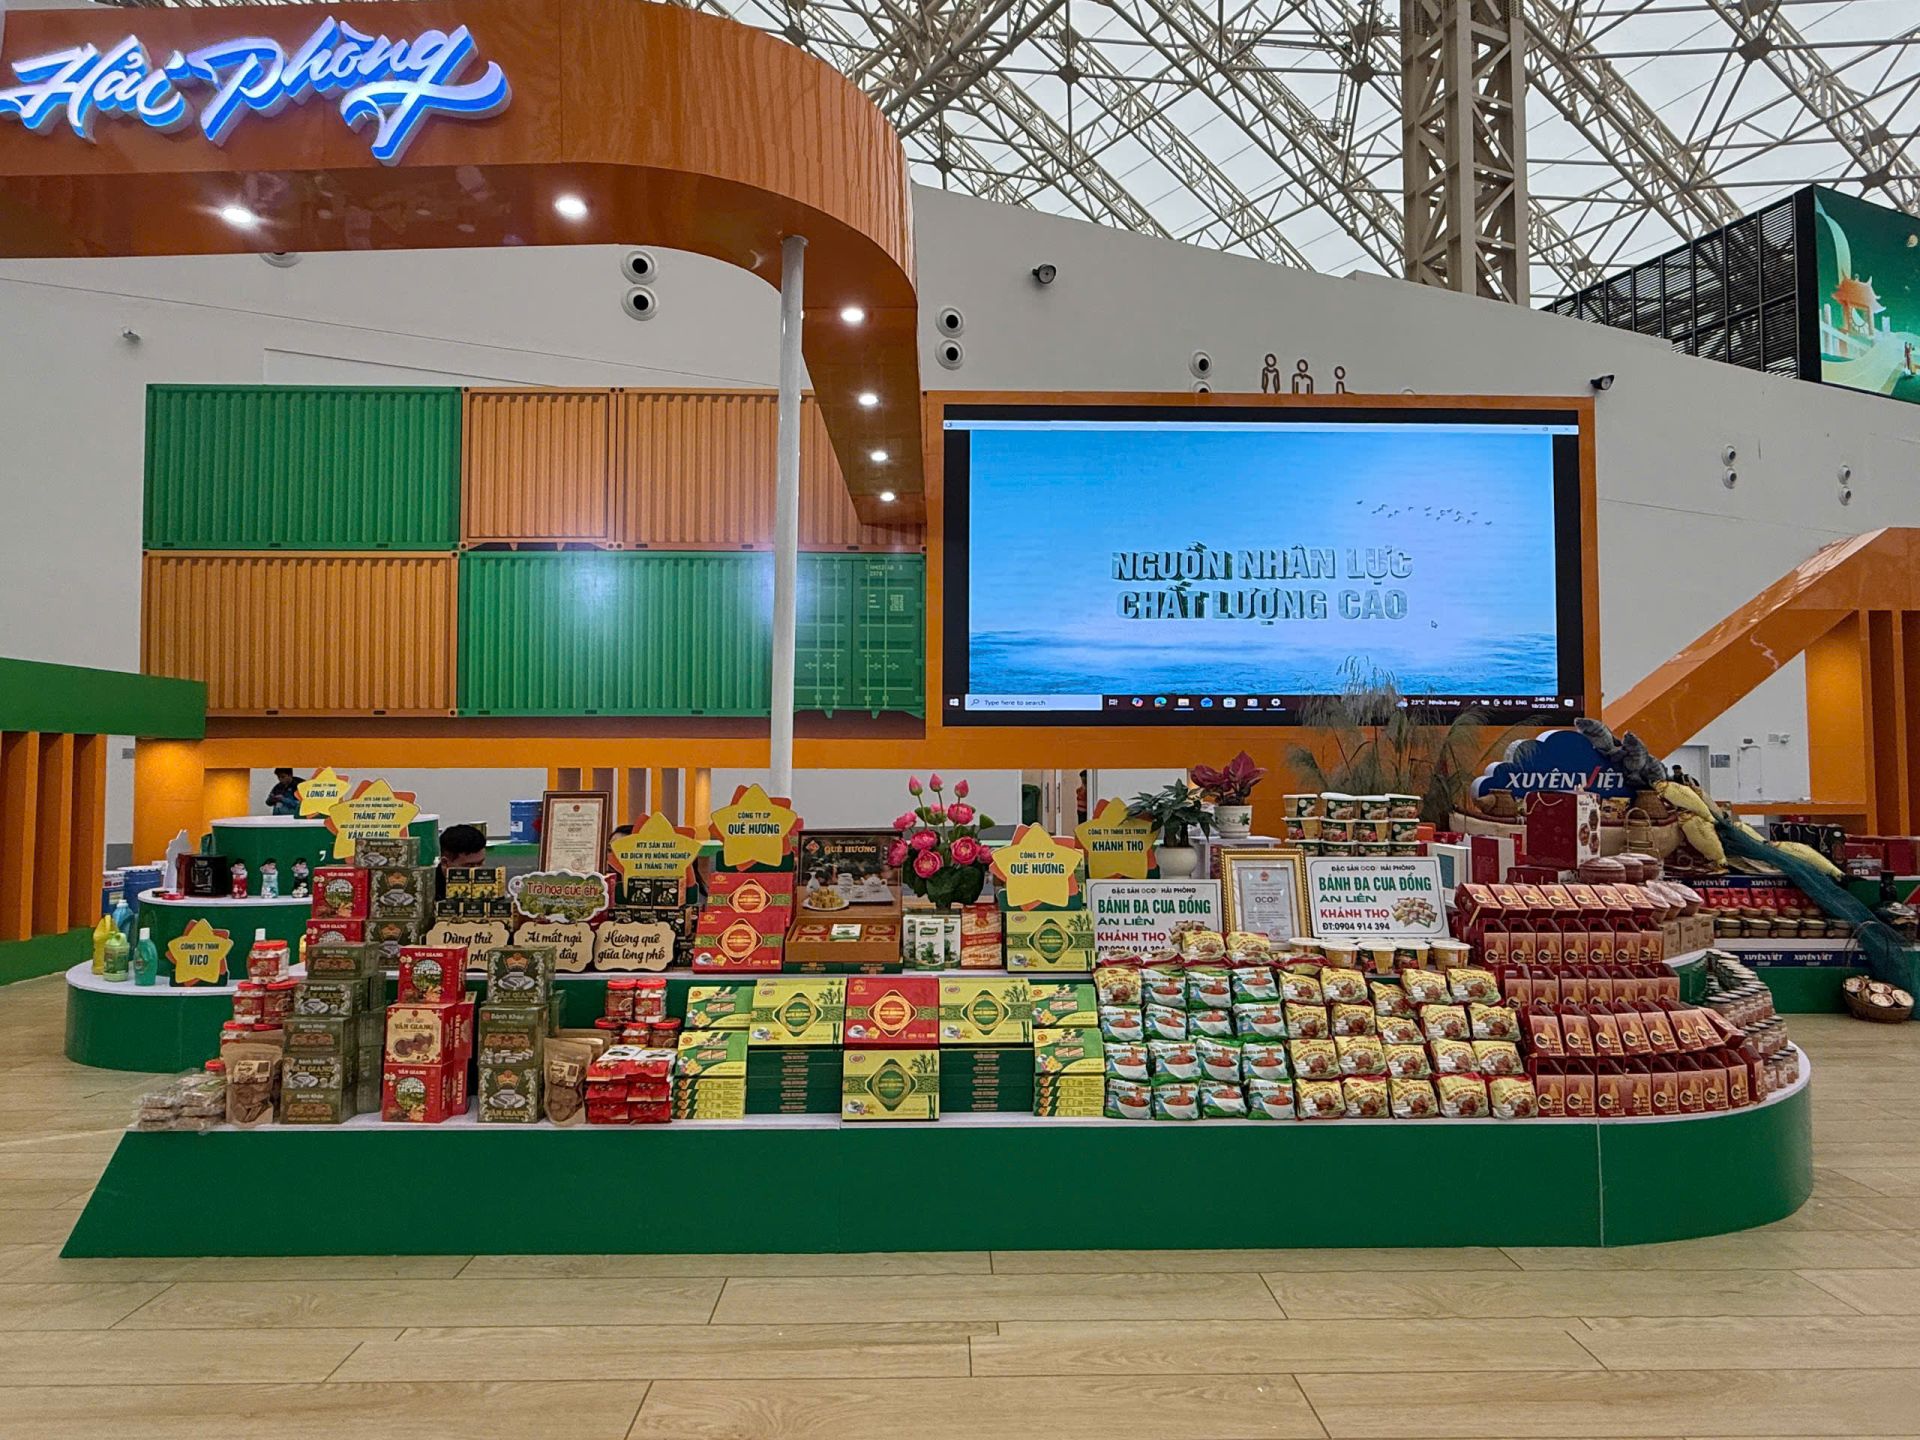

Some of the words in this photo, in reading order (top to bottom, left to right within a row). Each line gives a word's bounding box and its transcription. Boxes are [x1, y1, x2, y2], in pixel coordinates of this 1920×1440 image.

[190, 15, 511, 166] Phòng
[1111, 541, 1233, 580] NGUỒN
[1237, 543, 1336, 580] NHÂN
[1346, 545, 1414, 585] LỰC
[1116, 581, 1209, 620] CHẤT
[1212, 587, 1328, 626] LƯỢNG
[1338, 588, 1410, 620] CAO
[306, 790, 325, 798] LONG
[738, 811, 753, 819] CÔNG
[728, 822, 745, 836] QUÊ
[748, 823, 780, 835] HƯƠNG
[1092, 839, 1124, 852] KHÁNH
[1126, 840, 1144, 853] THỌ
[653, 851, 669, 859] NÔNG
[670, 852, 691, 860] NGHIỆP
[1019, 851, 1035, 859] CÔNG
[1010, 862, 1029, 876] QUÊ
[1031, 862, 1065, 875] HƯƠNG
[527, 881, 543, 894] Trà
[543, 881, 562, 895] hoa
[562, 882, 582, 896] cúc
[1318, 874, 1351, 891] BÁNH
[1354, 877, 1371, 891] ĐA
[1373, 877, 1397, 891] CUA
[1399, 872, 1432, 891] ĐỒNG
[1098, 896, 1130, 914] BÁNH
[1133, 899, 1150, 914] ĐA
[1152, 899, 1176, 914] CUA
[1178, 895, 1211, 914] ĐỒNG
[1320, 906, 1362, 918] KHÁNH
[1364, 908, 1390, 920] THỌ
[1322, 922, 1355, 930] ĐT:0904
[1357, 922, 1373, 930] 914
[1375, 922, 1391, 930] 394
[442, 932, 471, 946] Dùng
[474, 931, 493, 944] thử
[525, 931, 539, 943] Ai
[541, 929, 562, 943] mất
[563, 931, 582, 948] ngủ
[603, 930, 639, 948] Hương
[641, 933, 661, 948] quê
[1097, 929, 1139, 941] KHÁNH
[1141, 932, 1166, 944] THỌ
[180, 942, 195, 950] CÔNG
[1132, 945, 1148, 953] 914
[189, 954, 209, 966] VICO
[559, 949, 578, 964] đây
[598, 949, 620, 962] giữa
[622, 948, 644, 962] lòng
[646, 946, 666, 963] phố
